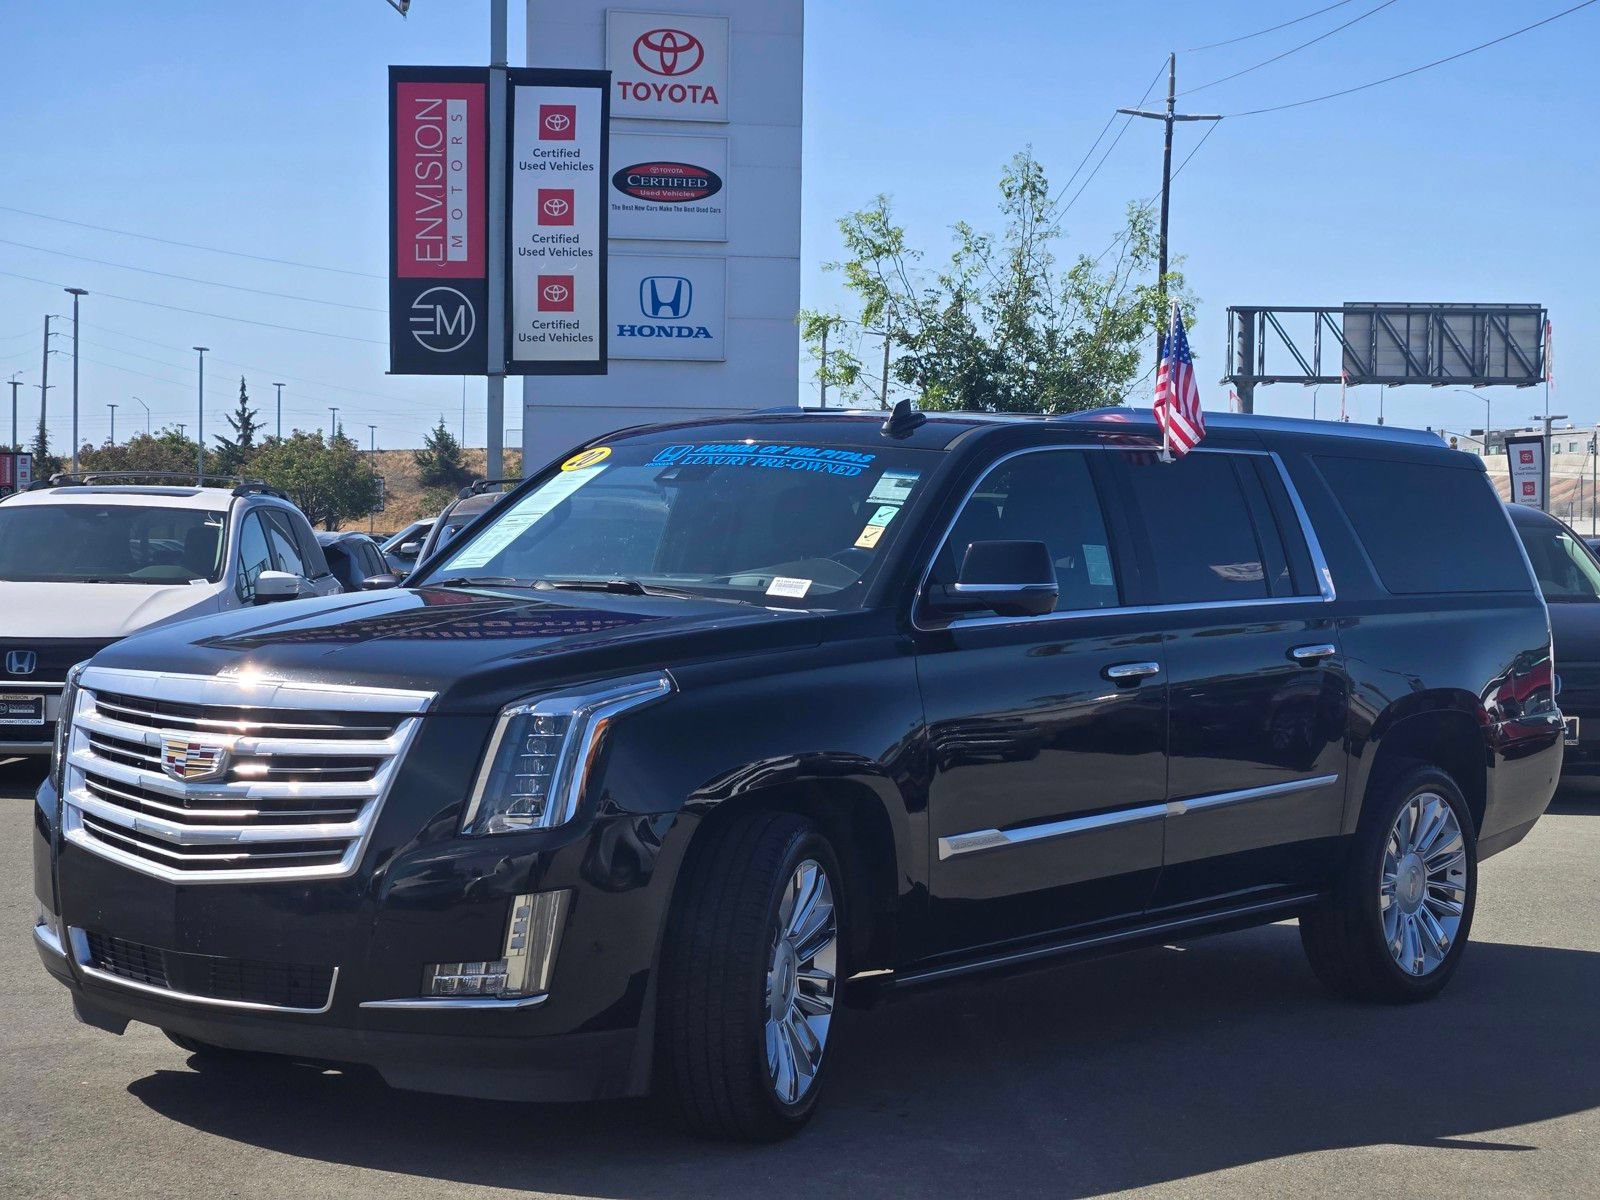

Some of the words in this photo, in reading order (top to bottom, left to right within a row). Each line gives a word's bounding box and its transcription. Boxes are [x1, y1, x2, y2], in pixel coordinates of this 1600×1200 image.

[617, 82, 719, 104] TOYOTA
[532, 148, 581, 158] Certified
[519, 161, 546, 171] Used
[549, 161, 594, 171] Vehicles
[415, 99, 443, 261] ENVISION
[451, 114, 463, 247] MOTORS
[627, 174, 708, 188] CERTIFIED
[662, 190, 695, 198] Vehicles
[532, 234, 580, 243] Certified
[518, 247, 545, 256] Used
[548, 247, 593, 257] Vehicles
[532, 320, 580, 329] Certified
[518, 333, 546, 342] Used
[548, 333, 594, 342] Vehicles
[616, 324, 713, 339] HONDA
[694, 444, 759, 453] HONDA
[759, 445, 790, 454] OF
[785, 447, 876, 463] MILPITAS
[679, 456, 755, 465] LUXURY
[750, 458, 862, 476] PRE-OWNED
